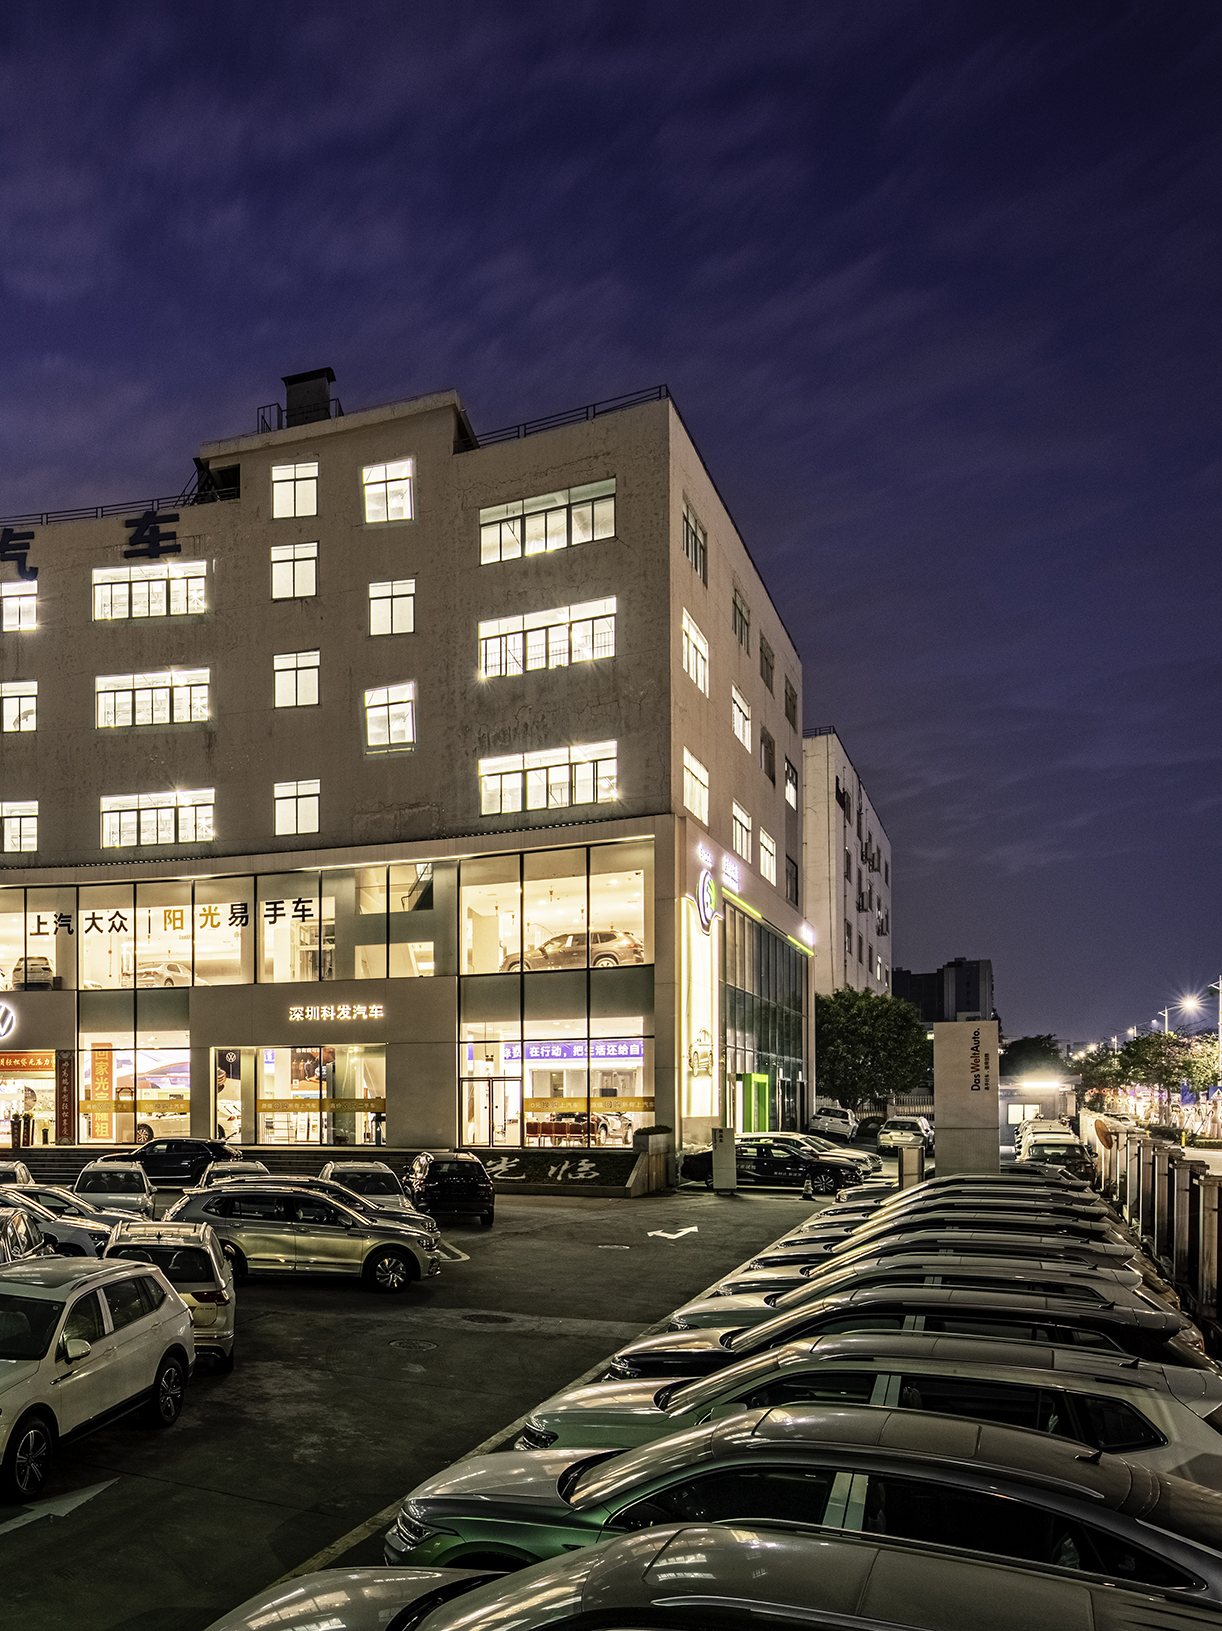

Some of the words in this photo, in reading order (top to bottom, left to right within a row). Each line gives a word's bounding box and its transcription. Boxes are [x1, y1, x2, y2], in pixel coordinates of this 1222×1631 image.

[29, 911, 129, 937] 上汽大众
[163, 897, 314, 931] 阳光易手车
[288, 1004, 384, 1021] 深圳科发汽车
[529, 1044, 643, 1057] 在行动，把生活还给自
[970, 1073, 981, 1091] Das
